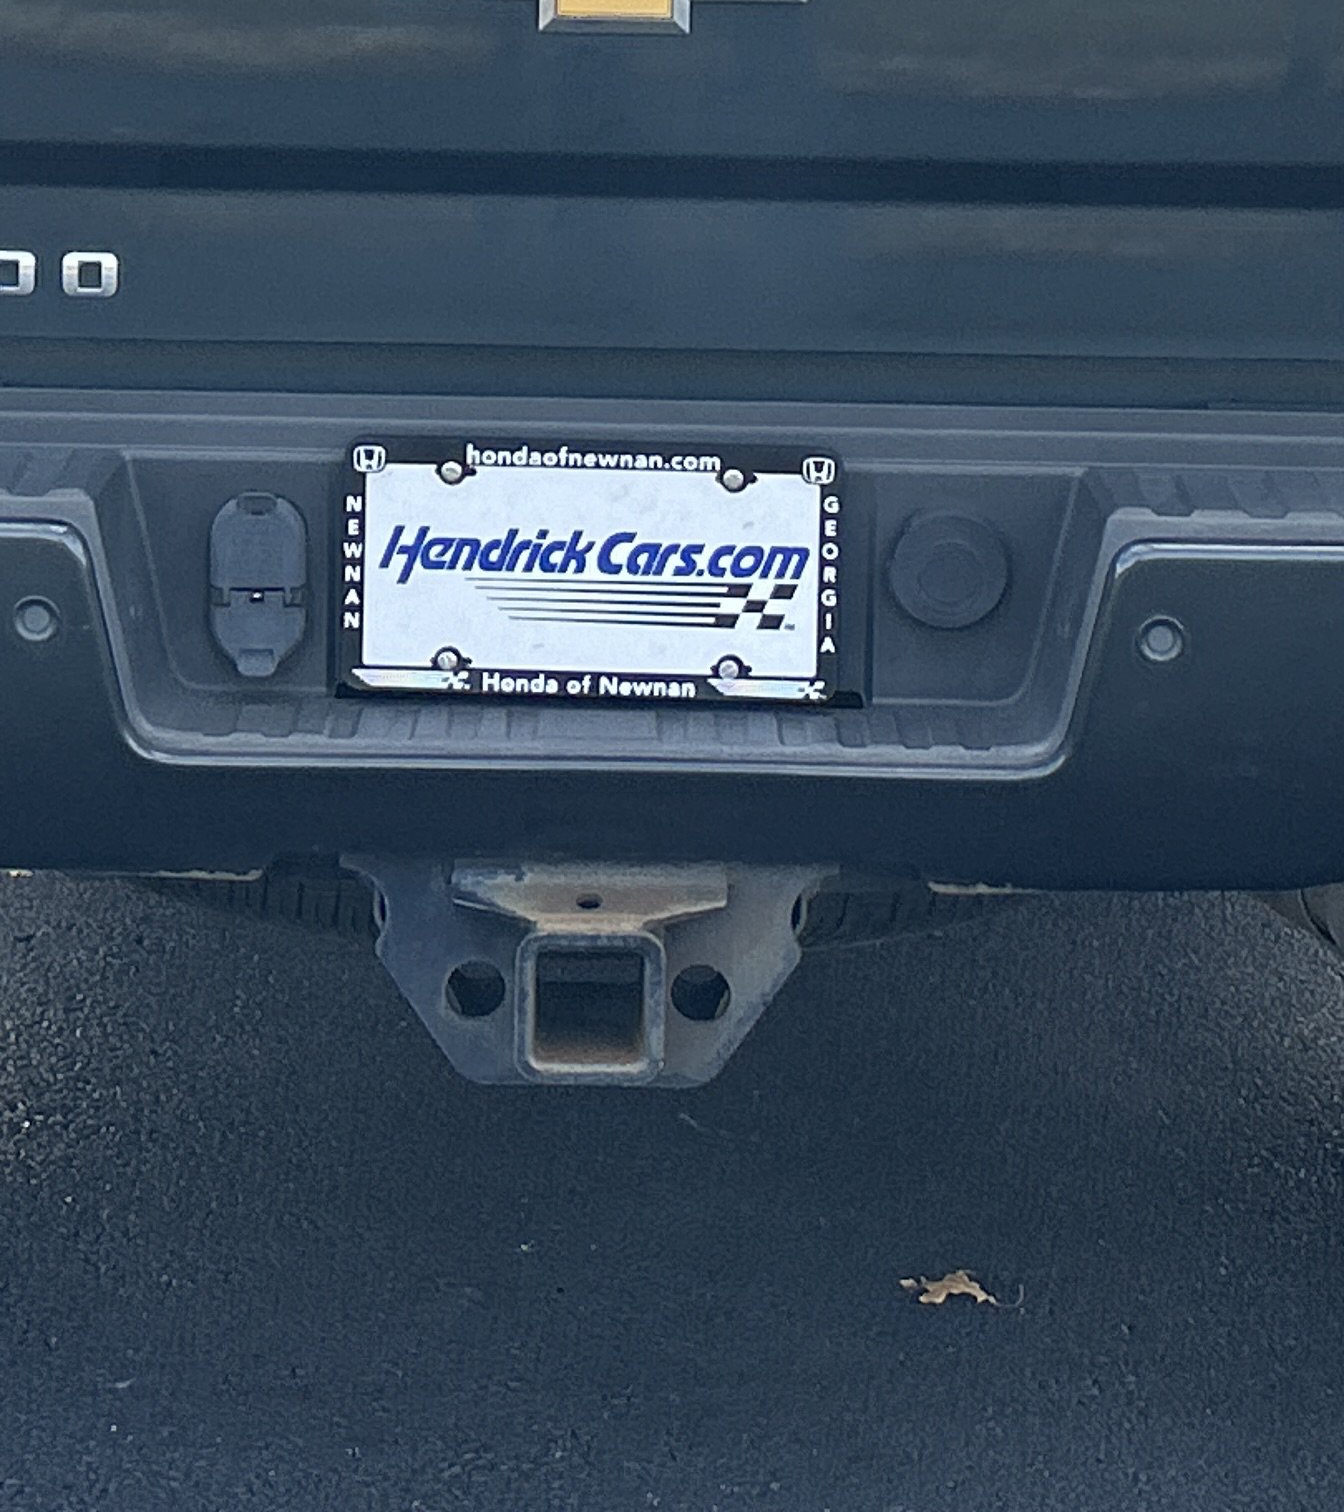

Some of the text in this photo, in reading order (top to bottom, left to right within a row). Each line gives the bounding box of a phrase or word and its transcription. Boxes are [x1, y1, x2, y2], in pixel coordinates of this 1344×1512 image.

[466, 444, 721, 472] hondaofnewnan.com
[343, 495, 363, 630] NEWNAN
[819, 495, 840, 655] GEORGIA
[482, 671, 696, 699] Honda of Newnan
